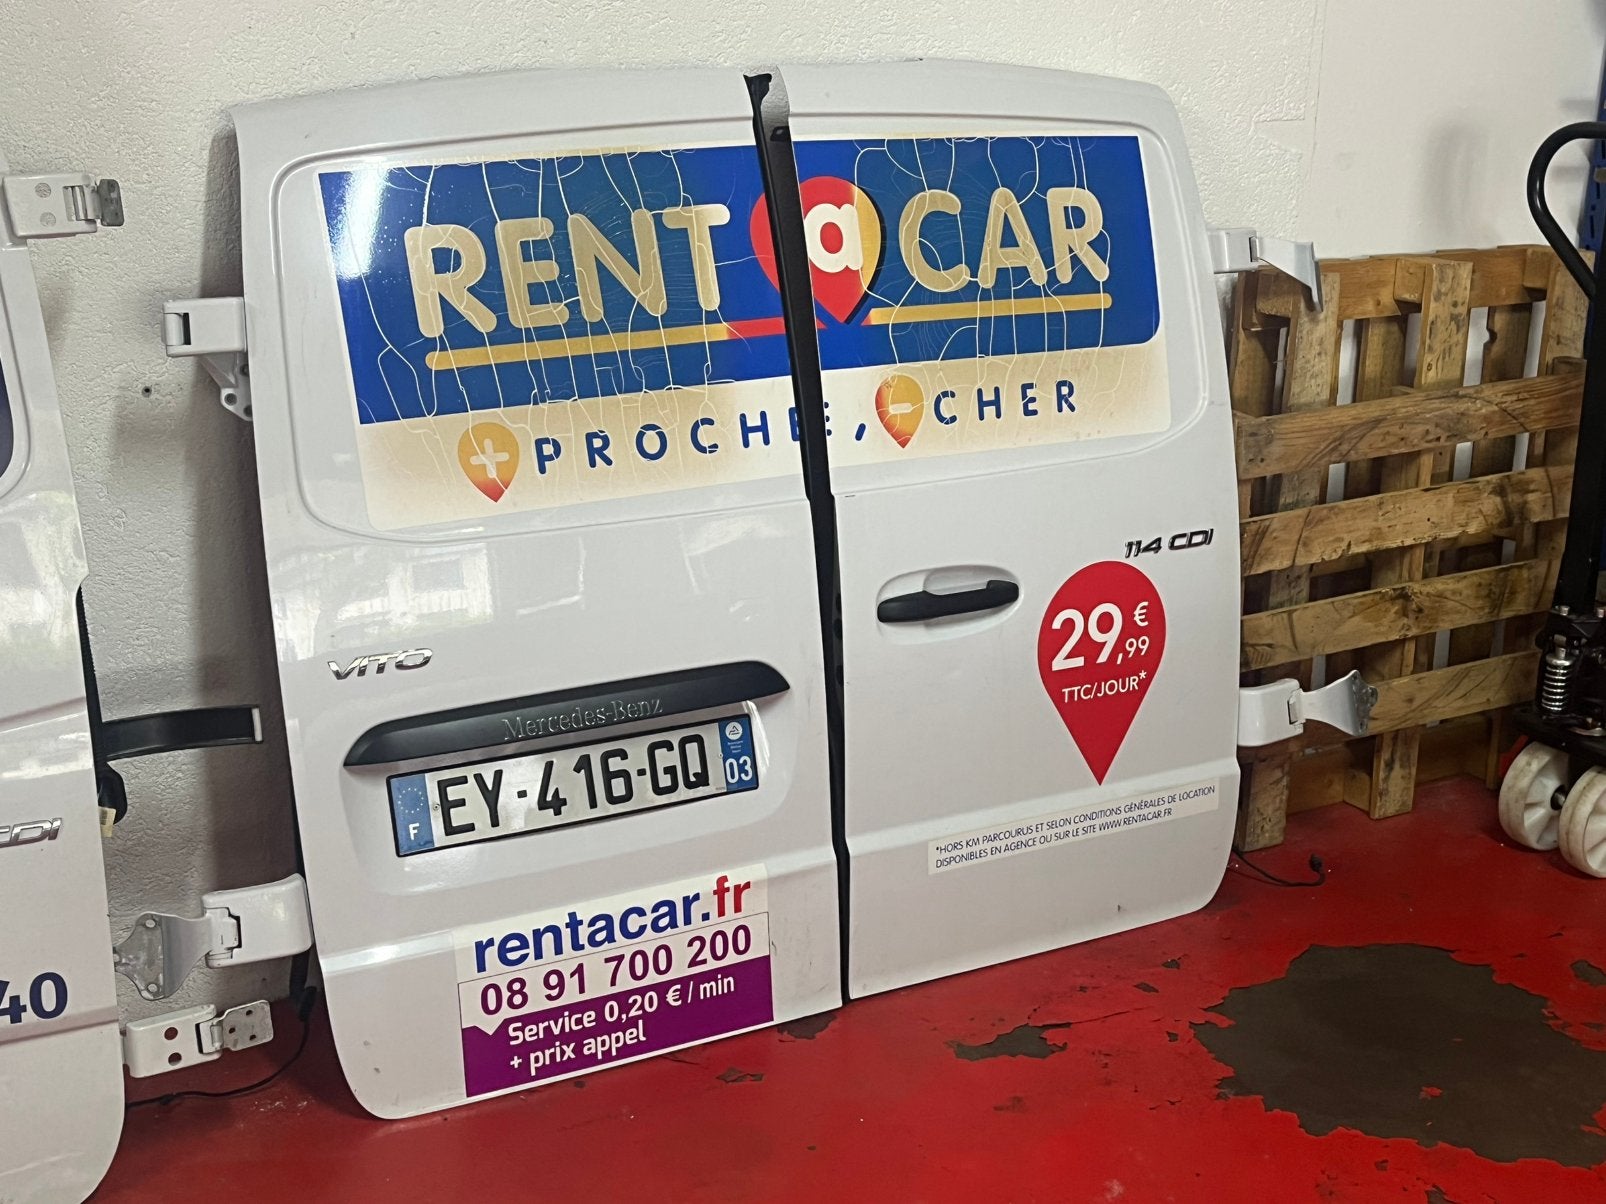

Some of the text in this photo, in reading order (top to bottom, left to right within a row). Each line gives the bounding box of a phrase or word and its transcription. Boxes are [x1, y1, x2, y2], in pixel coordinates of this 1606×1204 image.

[403, 203, 731, 338] RENT
[899, 186, 1110, 292] CAR
[933, 379, 1077, 425] CHER
[1125, 528, 1214, 558] 114 CDI
[328, 647, 433, 680] VITO
[501, 698, 664, 741] Mercedes-Benz
[437, 733, 711, 837] EY-416-GQ
[725, 755, 753, 784] 03
[408, 822, 420, 841] F
[966, 837, 980, 849] KM
[982, 825, 1034, 845] PARCOURUS
[1035, 822, 1044, 833] ET
[1046, 816, 1072, 831] SELON
[1073, 806, 1122, 824] CONDITIONS
[1123, 795, 1166, 814] GÉNÉRALES
[1167, 793, 1177, 804] DE
[1178, 785, 1216, 802] LOCATION
[935, 848, 989, 869] DISPONIBLES
[990, 845, 1002, 856] EN
[1003, 837, 1037, 853] AGENCE
[1039, 834, 1053, 845] OU
[1054, 830, 1070, 842] SUR
[1071, 828, 1080, 838] LE
[1081, 824, 1097, 836] SITE
[474, 875, 751, 974] rentacar.fr
[480, 923, 752, 1016] 08 91 700 200
[508, 1008, 597, 1046] Service
[603, 990, 659, 1024] 0,20
[665, 984, 683, 1007] €
[699, 974, 735, 1001] min
[528, 1041, 576, 1077] prix
[582, 1019, 647, 1061] appel
